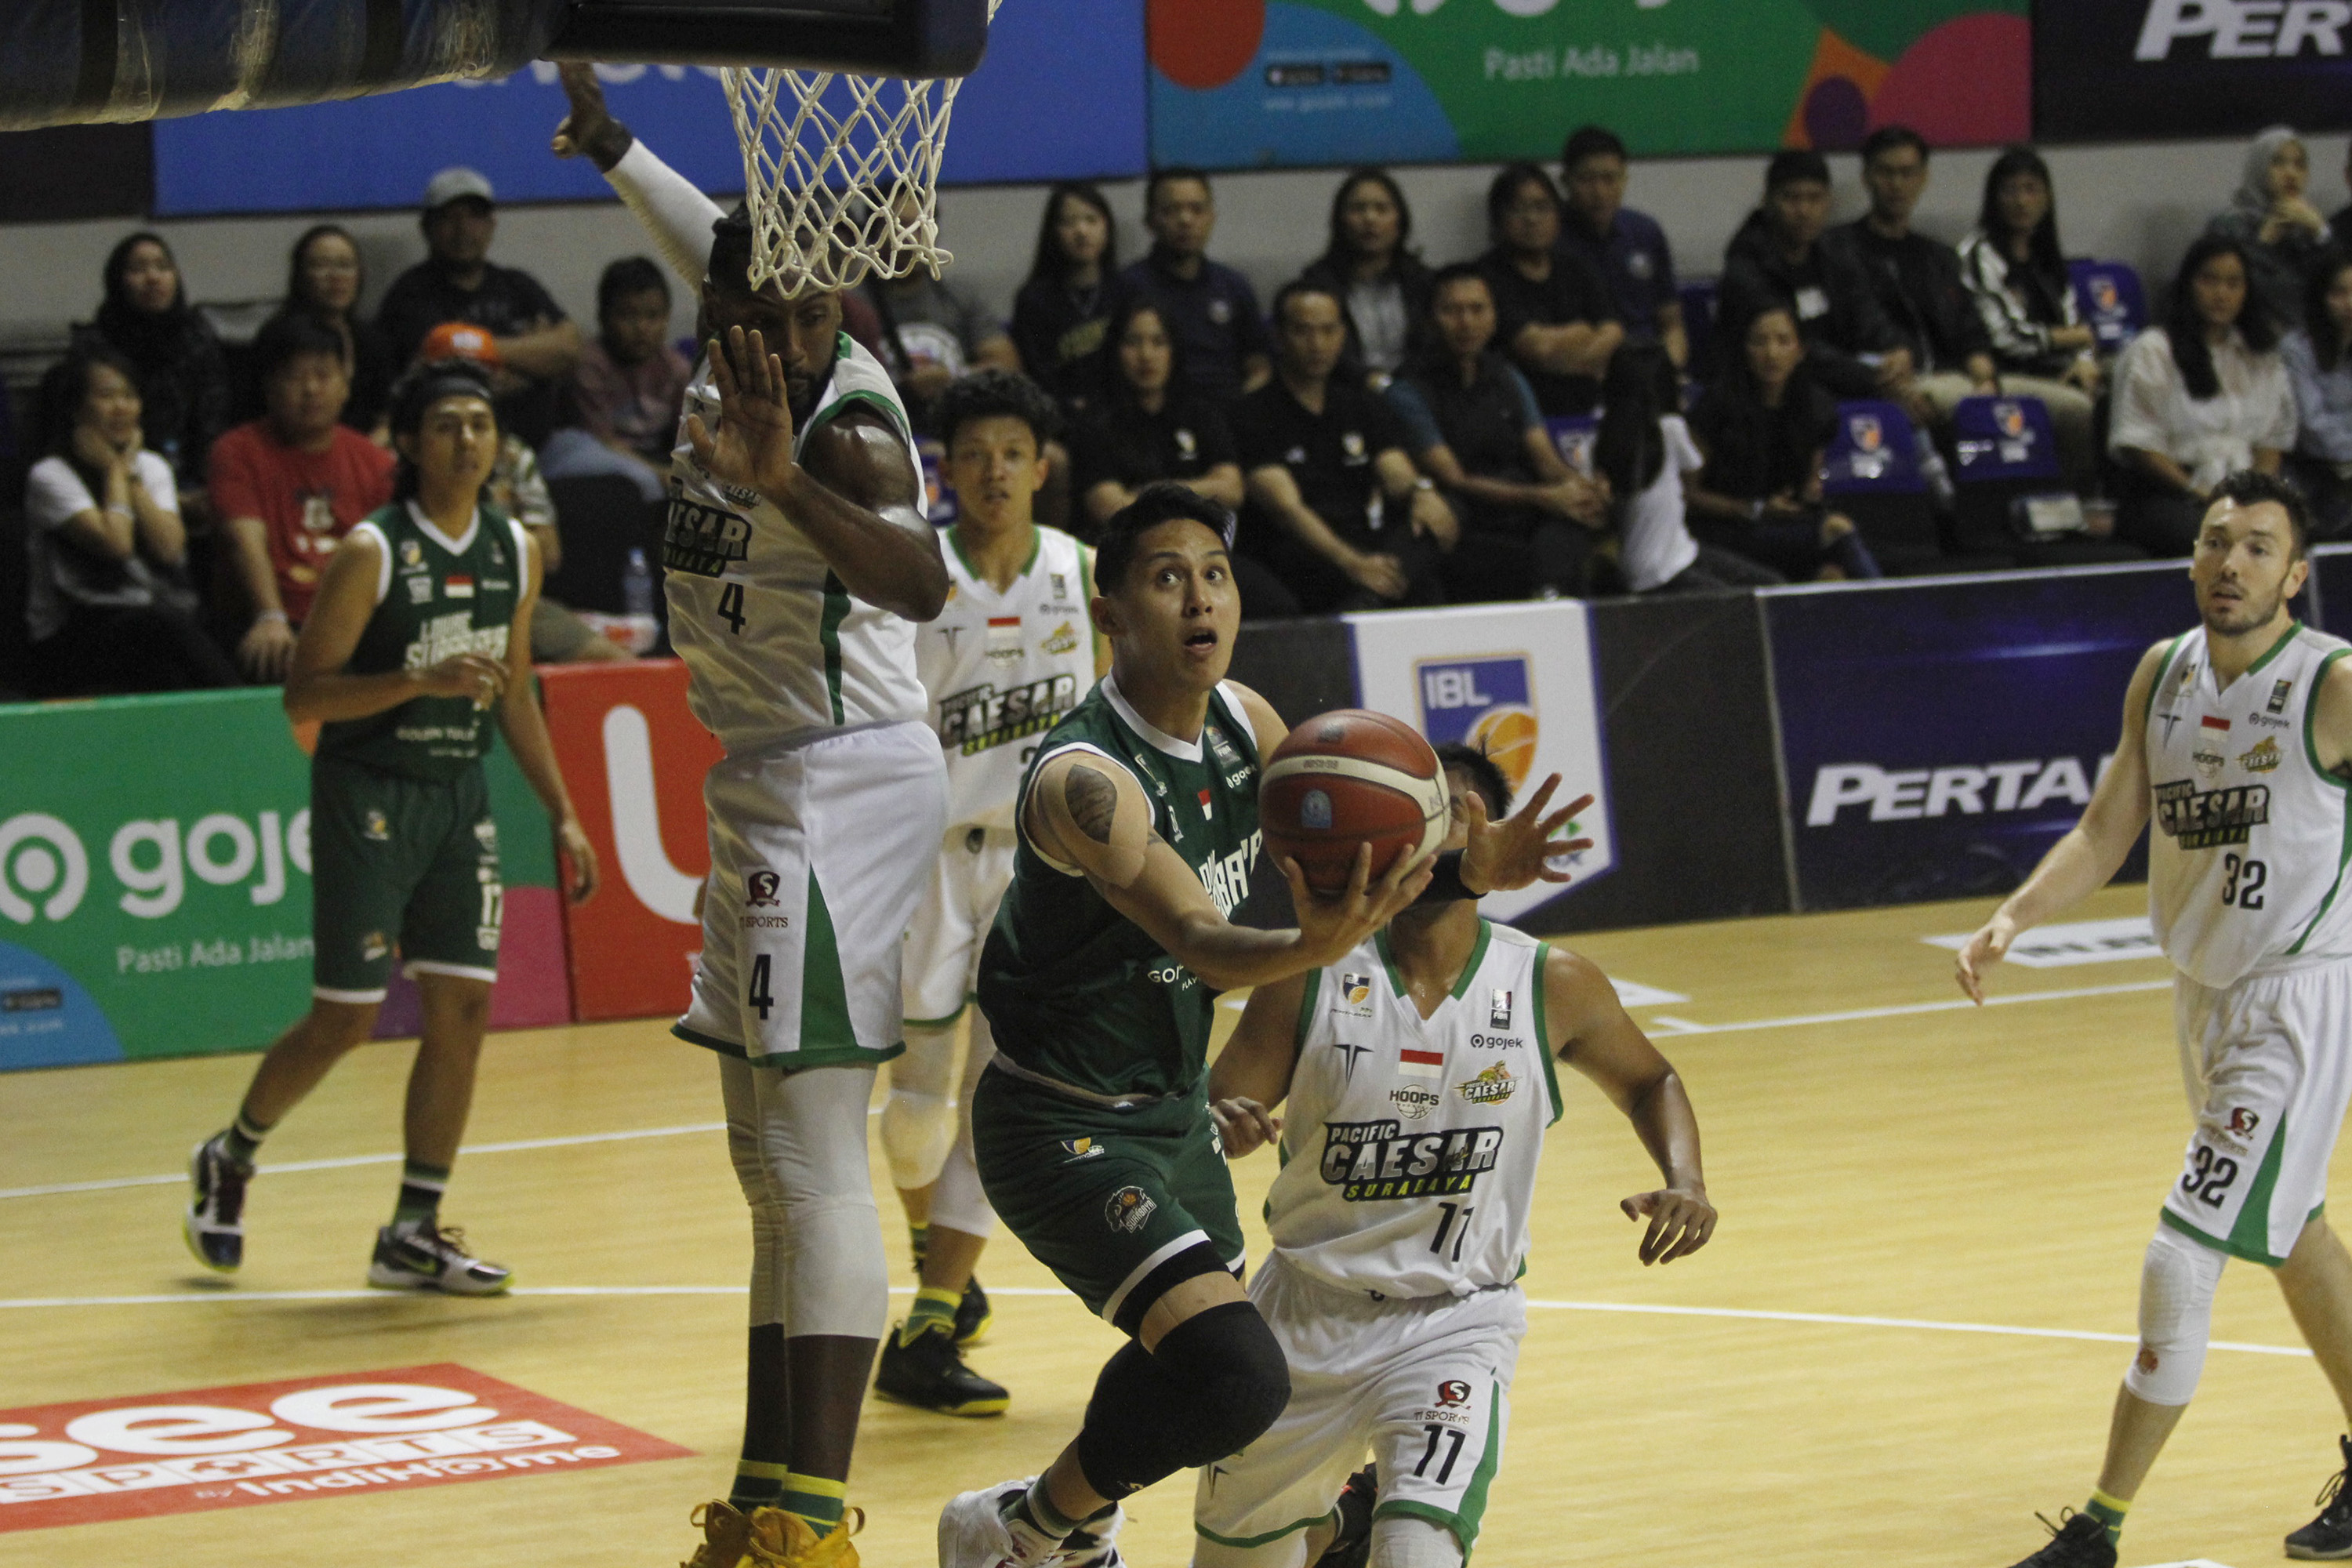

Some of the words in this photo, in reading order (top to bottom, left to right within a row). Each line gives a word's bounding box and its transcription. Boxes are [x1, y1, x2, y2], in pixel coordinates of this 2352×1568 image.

[1485, 47, 1555, 80] Pasti
[1563, 45, 1618, 77] Ada
[1626, 41, 1699, 74] Jalan
[717, 583, 746, 636] 4
[941, 676, 1074, 747] CAESAR
[1425, 668, 1492, 710] IBL
[1806, 753, 2116, 827] PERTA
[2158, 786, 2267, 837] CAESAR
[2222, 852, 2267, 910] 32
[744, 916, 788, 929] SPORTS
[116, 943, 183, 975] Pasti
[190, 939, 241, 969] Ada
[748, 953, 774, 1020] 4
[1486, 1036, 1523, 1051] gojek
[1389, 1090, 1439, 1106] HOOPS
[1465, 1081, 1515, 1099] CAESAR
[1322, 1129, 1494, 1181] CAESAR
[1330, 1123, 1396, 1143] PACIFIC
[1345, 1175, 1470, 1200] SURABAYA
[2182, 1145, 2238, 1210] 32
[1430, 1203, 1475, 1262] 11
[1425, 1410, 1469, 1425] SPORTS
[237, 1444, 621, 1497] IndiHome
[1414, 1424, 1466, 1486] 11
